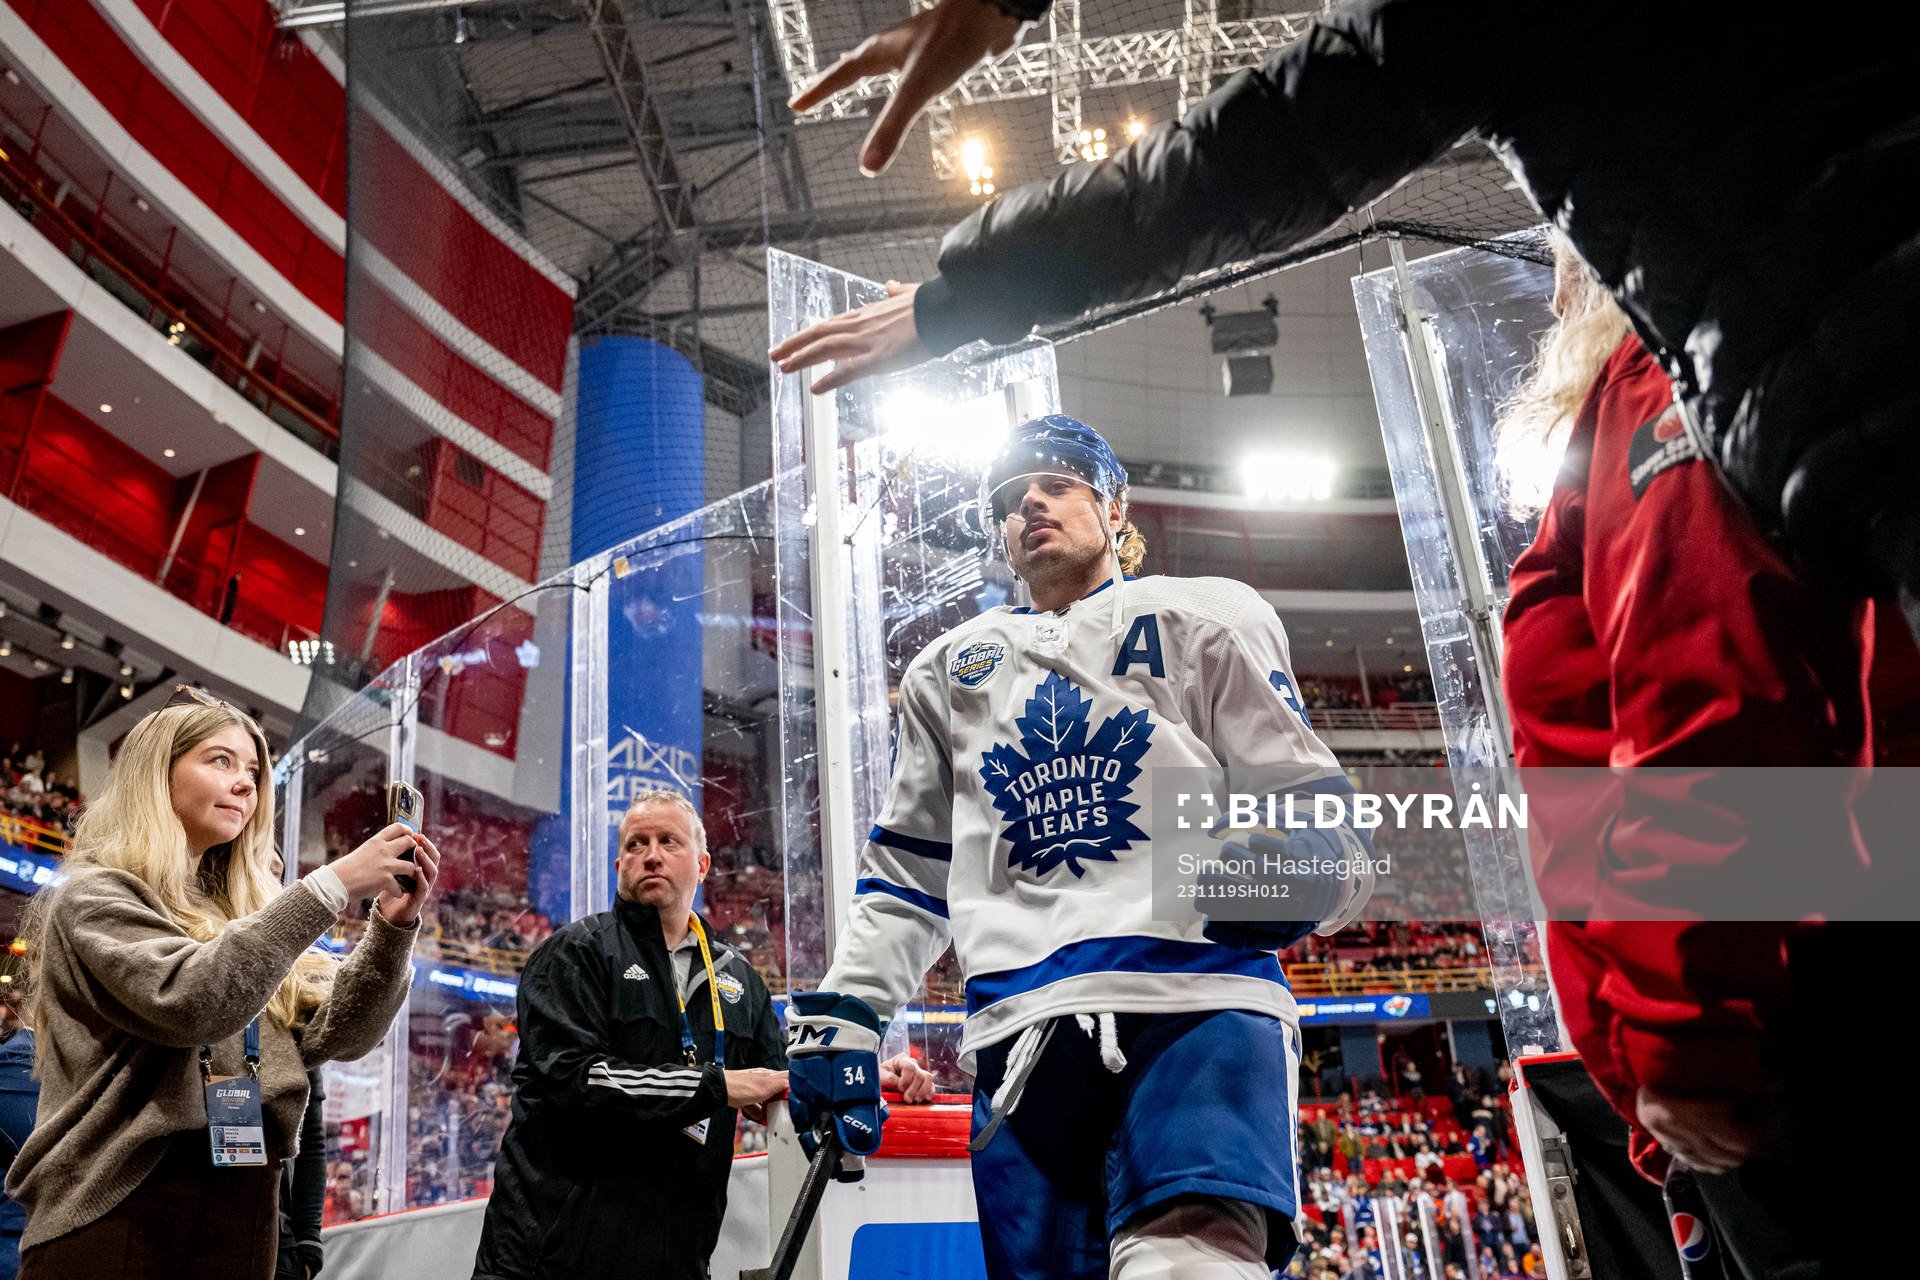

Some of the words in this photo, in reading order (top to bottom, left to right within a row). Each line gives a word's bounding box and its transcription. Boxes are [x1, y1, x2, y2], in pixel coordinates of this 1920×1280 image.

[951, 646, 1005, 673] GLOBAL
[1111, 613, 1166, 679] A
[1004, 755, 1122, 802] TORONTO
[1025, 781, 1106, 817] MAPLE
[1028, 805, 1109, 841] LEAFS
[843, 1066, 865, 1086] 34
[216, 1089, 251, 1099] GLOBAL
[843, 1114, 872, 1134] CCM
